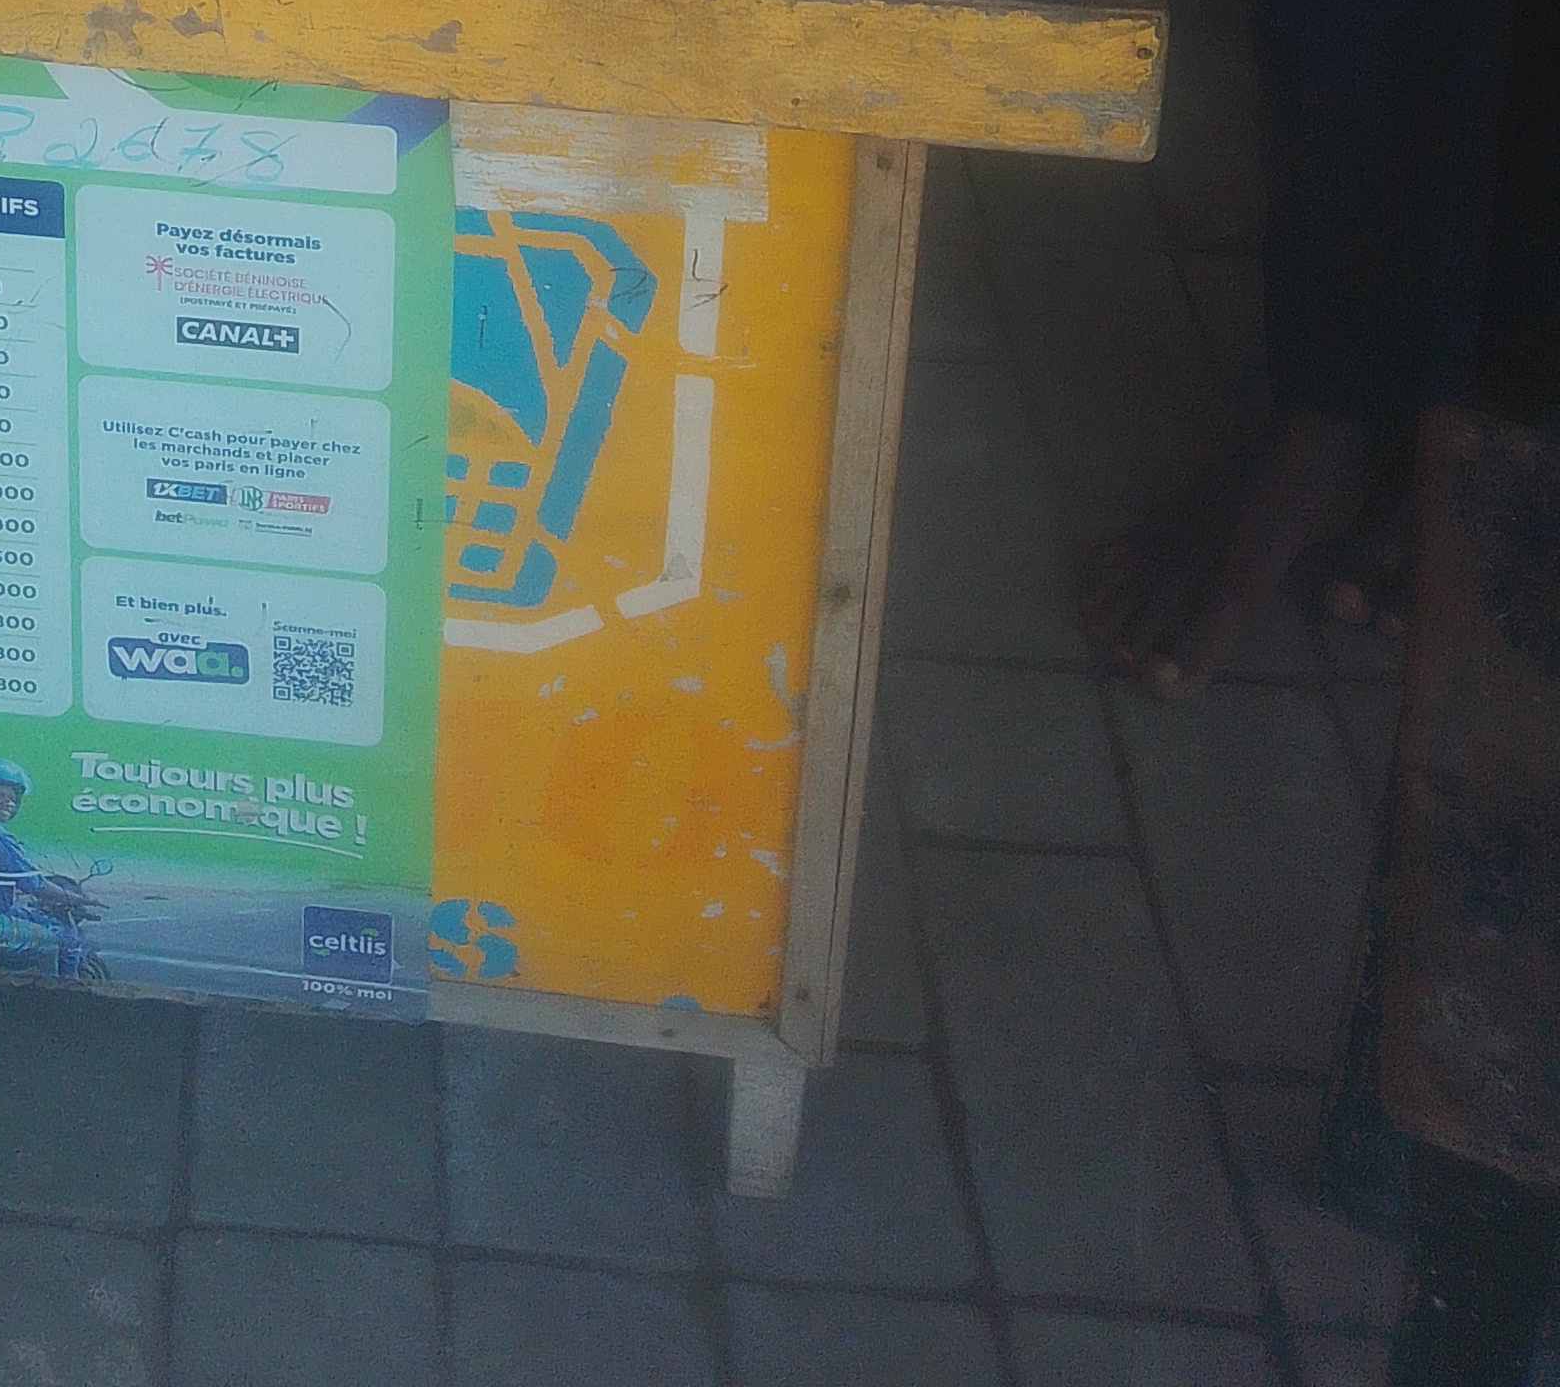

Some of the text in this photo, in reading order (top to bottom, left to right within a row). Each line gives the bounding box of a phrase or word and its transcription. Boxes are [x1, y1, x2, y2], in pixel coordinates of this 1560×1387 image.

[155, 221, 323, 251] Payez désormais
[176, 242, 297, 264] vos factures
[173, 279, 245, 297] D'ÉNERGIE
[174, 266, 307, 289] SOCIÉTÉ BÉNINOISE
[180, 320, 294, 349] CANAL+
[102, 420, 361, 455] Utilisez C'cash pour payer chez
[133, 437, 331, 468] les marchands et placer
[161, 456, 306, 480] vos paris en ligne
[153, 482, 220, 502] 1XBET
[114, 595, 135, 609] Et
[140, 597, 180, 613] bien
[157, 631, 202, 646] avec
[70, 750, 356, 809] Toujours plus
[301, 979, 393, 1001] 100% moi
